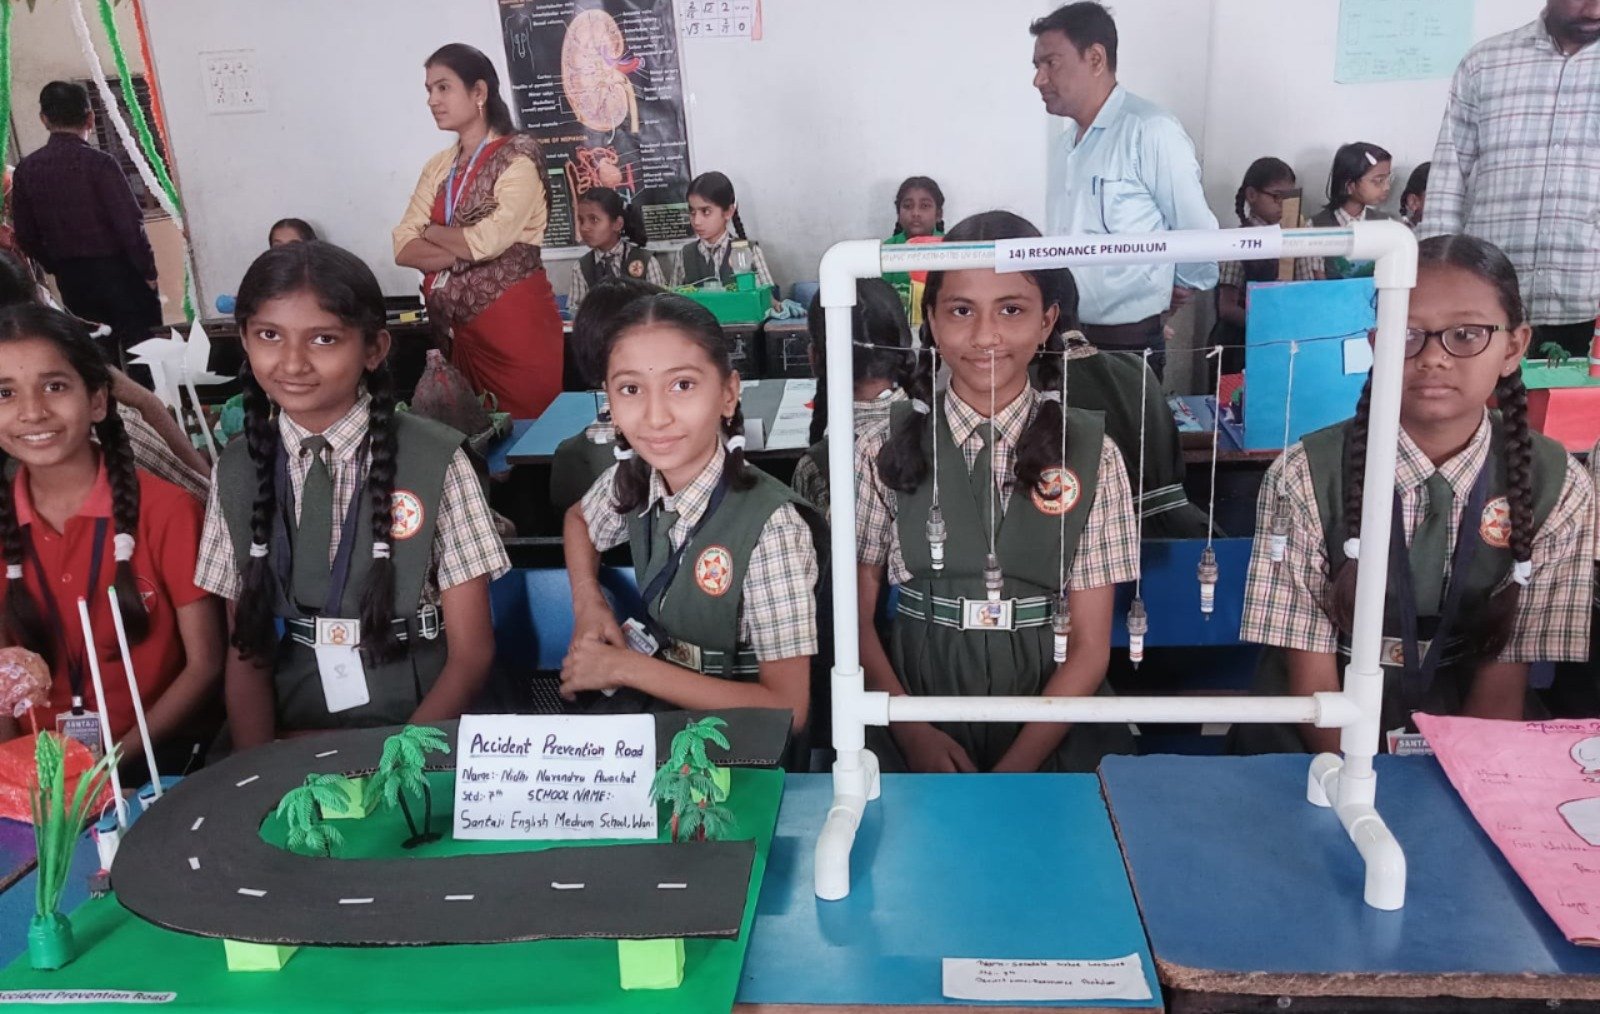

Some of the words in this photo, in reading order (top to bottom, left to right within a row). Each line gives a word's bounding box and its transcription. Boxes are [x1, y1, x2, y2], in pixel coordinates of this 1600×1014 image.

[1009, 248, 1026, 260] 14)
[1028, 244, 1097, 258] RESONANCE
[1100, 241, 1167, 254] PENDULUM
[470, 732, 532, 755] Accident
[542, 733, 605, 757] Prevention
[615, 740, 645, 757] Road
[528, 787, 570, 802] SCHOOL
[460, 808, 505, 830] Santaji
[511, 810, 549, 833] English
[54, 991, 130, 1000] Prevention
